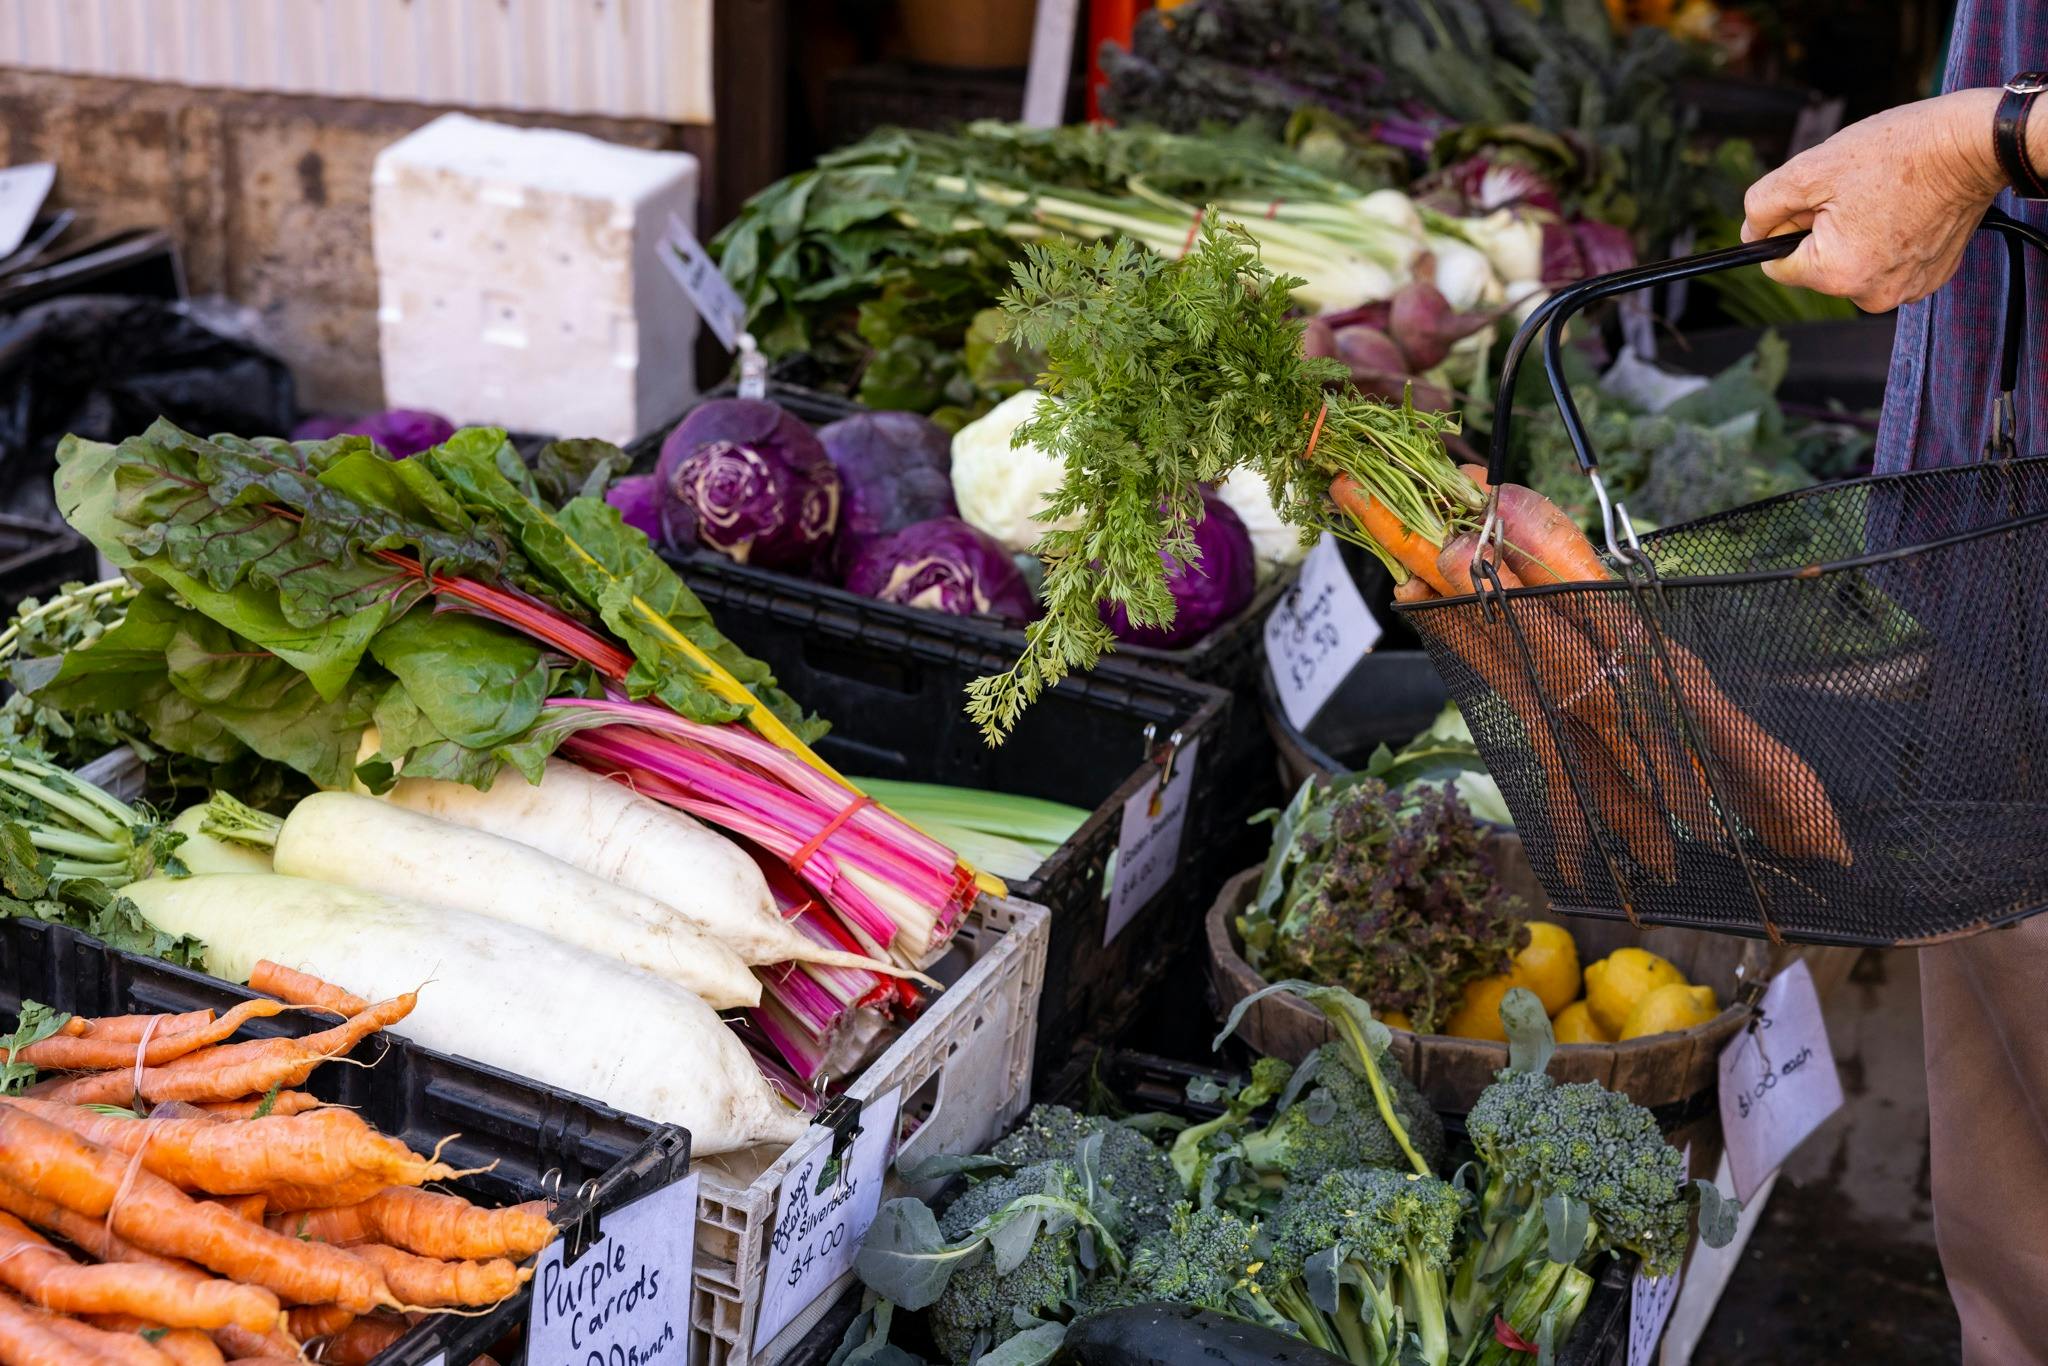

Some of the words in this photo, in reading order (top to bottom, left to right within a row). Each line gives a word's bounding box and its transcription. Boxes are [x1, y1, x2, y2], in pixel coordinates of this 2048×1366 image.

[1781, 1045, 1813, 1075] each
[543, 1236, 626, 1326] Purple
[787, 1222, 845, 1288] $4.00
[571, 1264, 660, 1350] Carrots
[628, 1320, 674, 1366] Bunch
